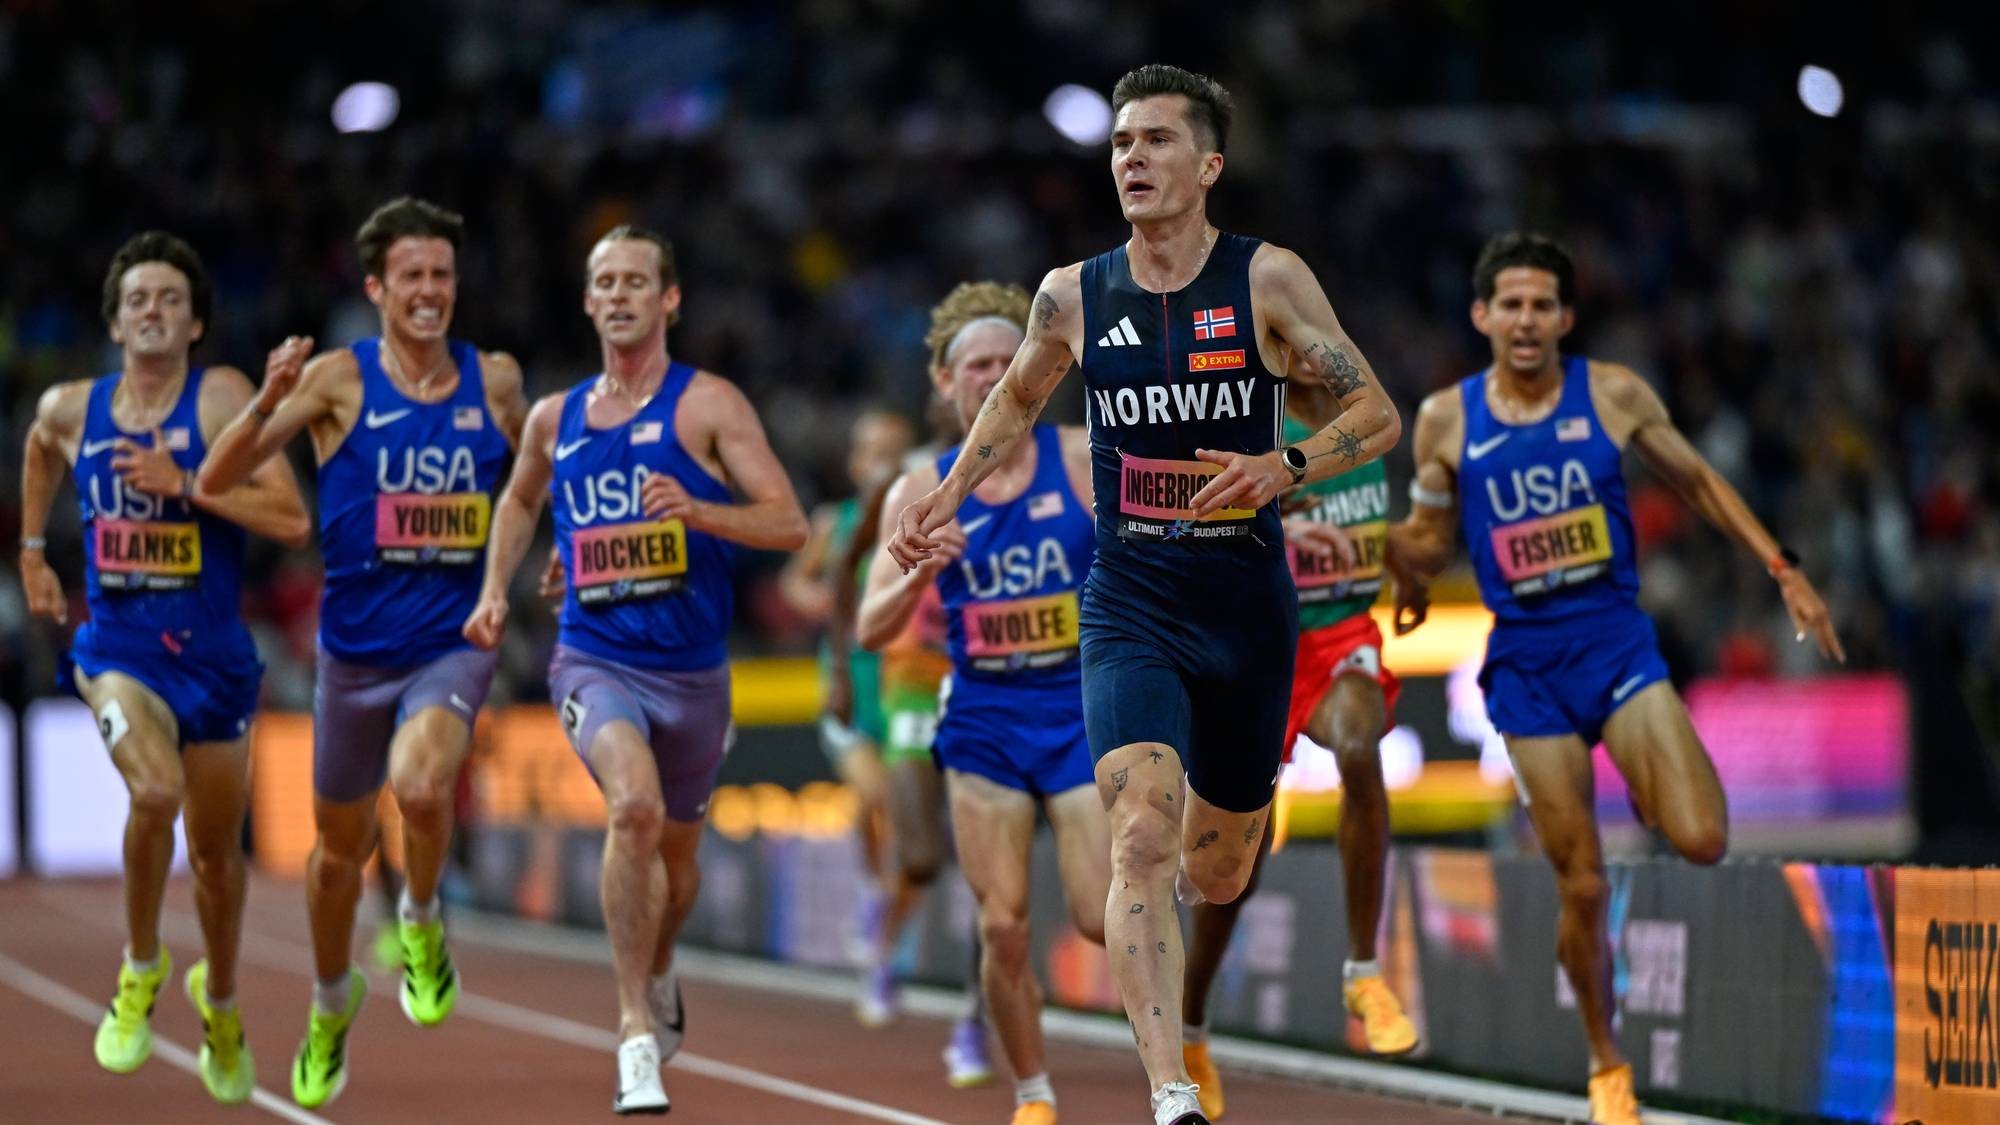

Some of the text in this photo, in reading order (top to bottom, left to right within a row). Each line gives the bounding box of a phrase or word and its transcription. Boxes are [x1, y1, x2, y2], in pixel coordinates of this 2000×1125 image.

[1209, 355, 1241, 365] EXTRA
[1094, 377, 1256, 427] NORWAY
[378, 446, 477, 493] USA
[1485, 458, 1596, 521] USA
[395, 504, 477, 538] YOUNG
[1128, 521, 1164, 536] ULTIMATE
[1193, 526, 1236, 538] BUDAPEST
[103, 529, 194, 566] BLANKS
[581, 532, 679, 576] HOCKER
[962, 537, 1073, 598] USA
[1509, 520, 1597, 570] FISHER
[977, 605, 1066, 645] WOLFE
[1924, 917, 2000, 1091] SEIK
